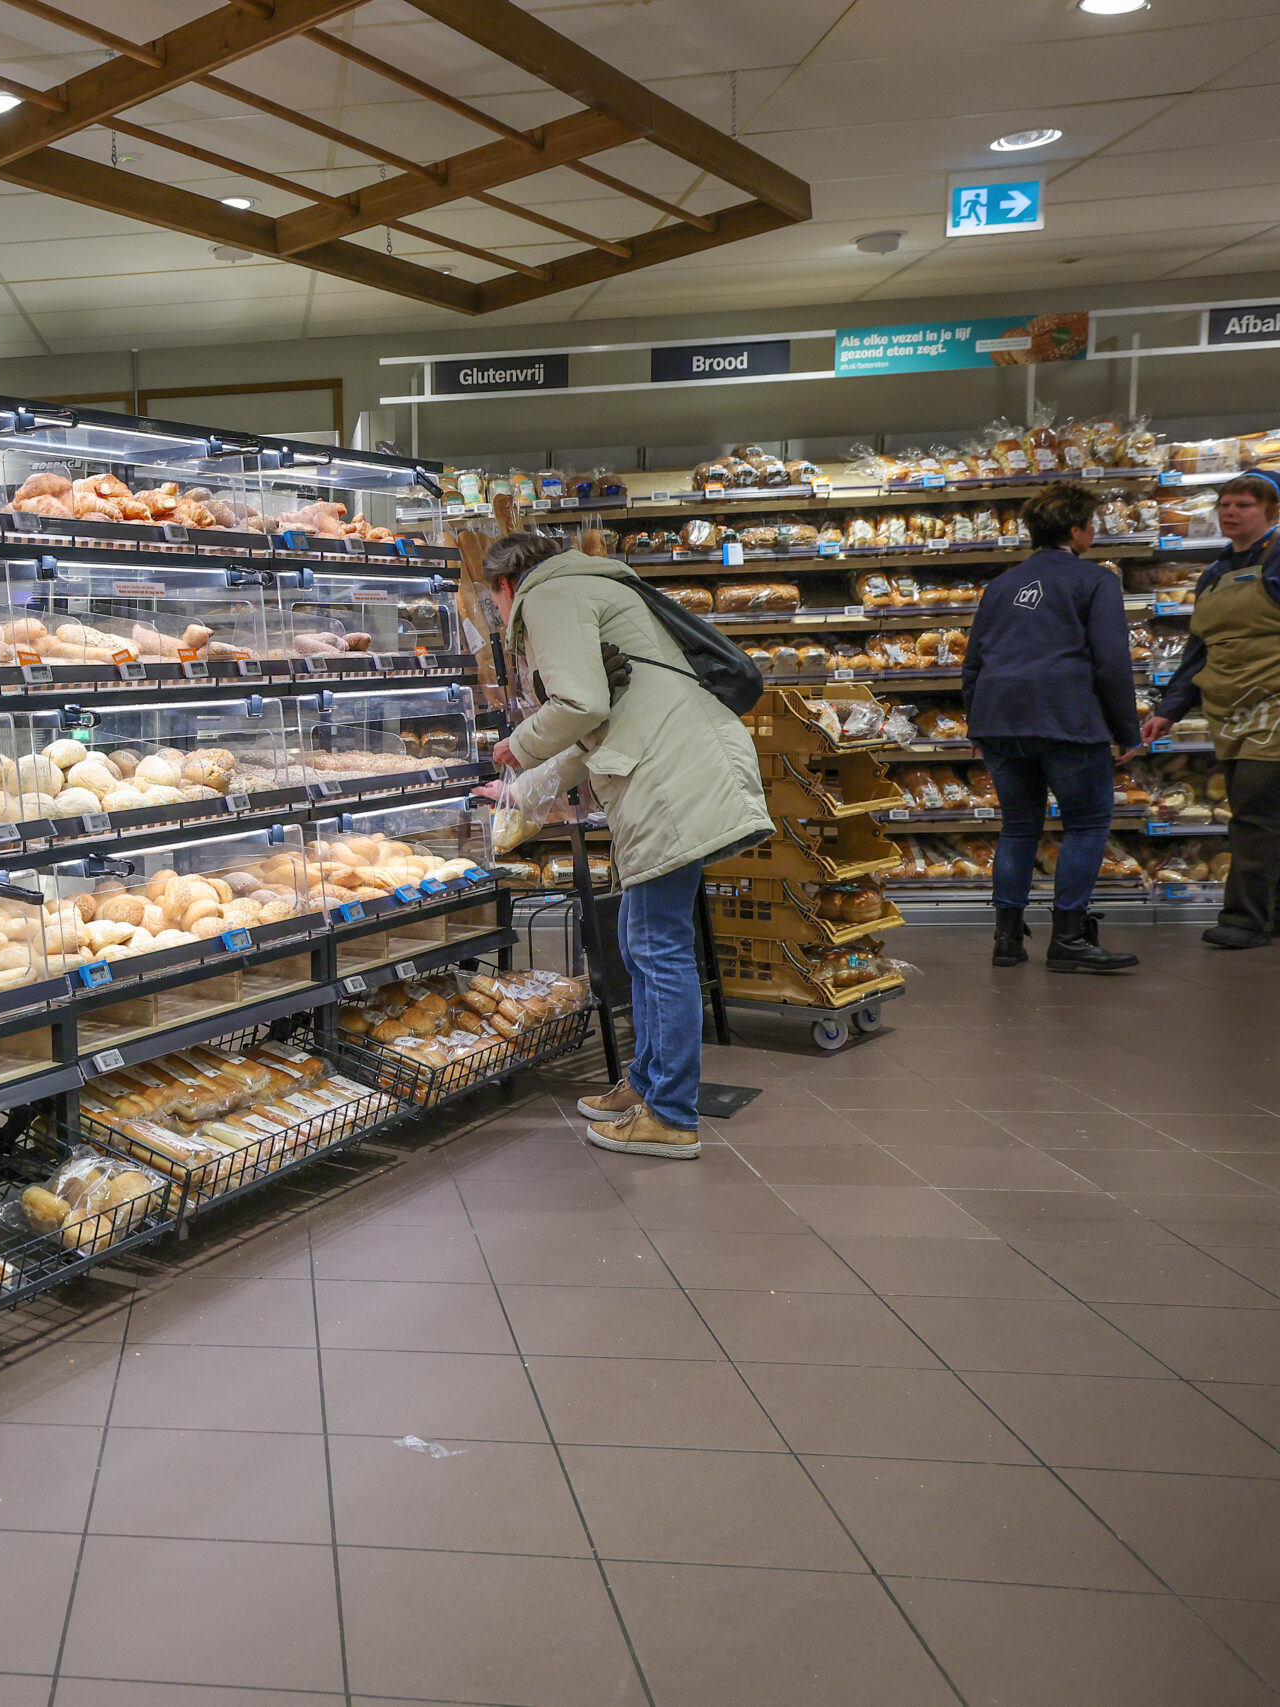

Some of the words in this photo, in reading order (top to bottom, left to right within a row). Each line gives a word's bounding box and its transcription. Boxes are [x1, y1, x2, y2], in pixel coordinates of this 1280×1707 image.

[841, 335, 860, 347] Als
[863, 334, 888, 345] elke
[892, 331, 923, 344] vezel
[926, 330, 937, 341] in
[940, 328, 952, 342] je
[956, 327, 972, 341] lijf
[840, 346, 884, 362] gezond
[886, 344, 914, 357] eten
[916, 342, 947, 356] zegt.
[692, 352, 748, 373] Brood
[459, 363, 545, 386] Glutenvrij
